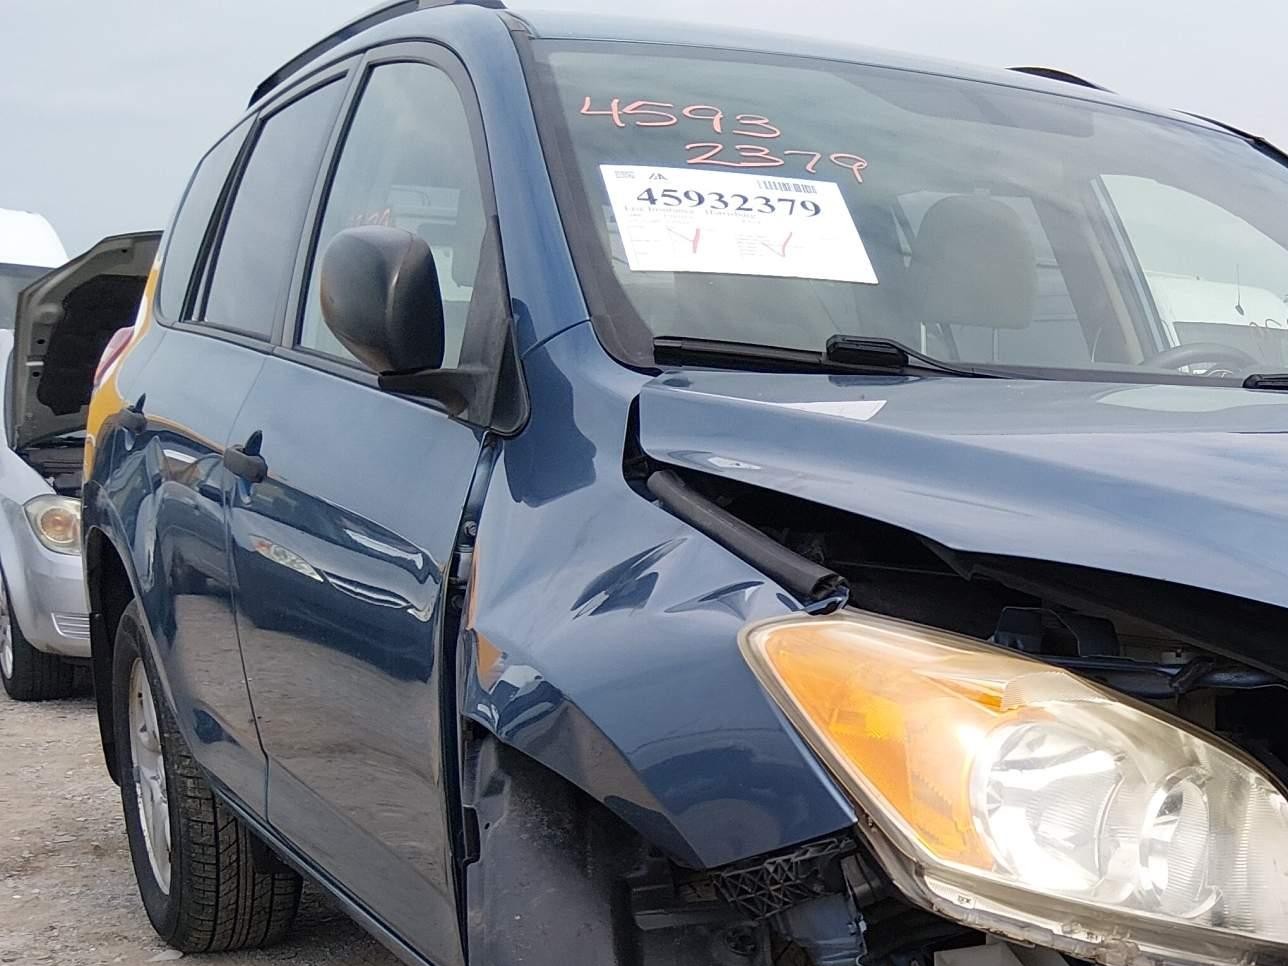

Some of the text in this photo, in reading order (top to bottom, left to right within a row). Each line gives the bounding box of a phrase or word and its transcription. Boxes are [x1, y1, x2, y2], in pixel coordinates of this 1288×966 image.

[580, 96, 782, 139] 4593
[685, 142, 868, 184] 2379
[636, 186, 822, 218] 45932379
